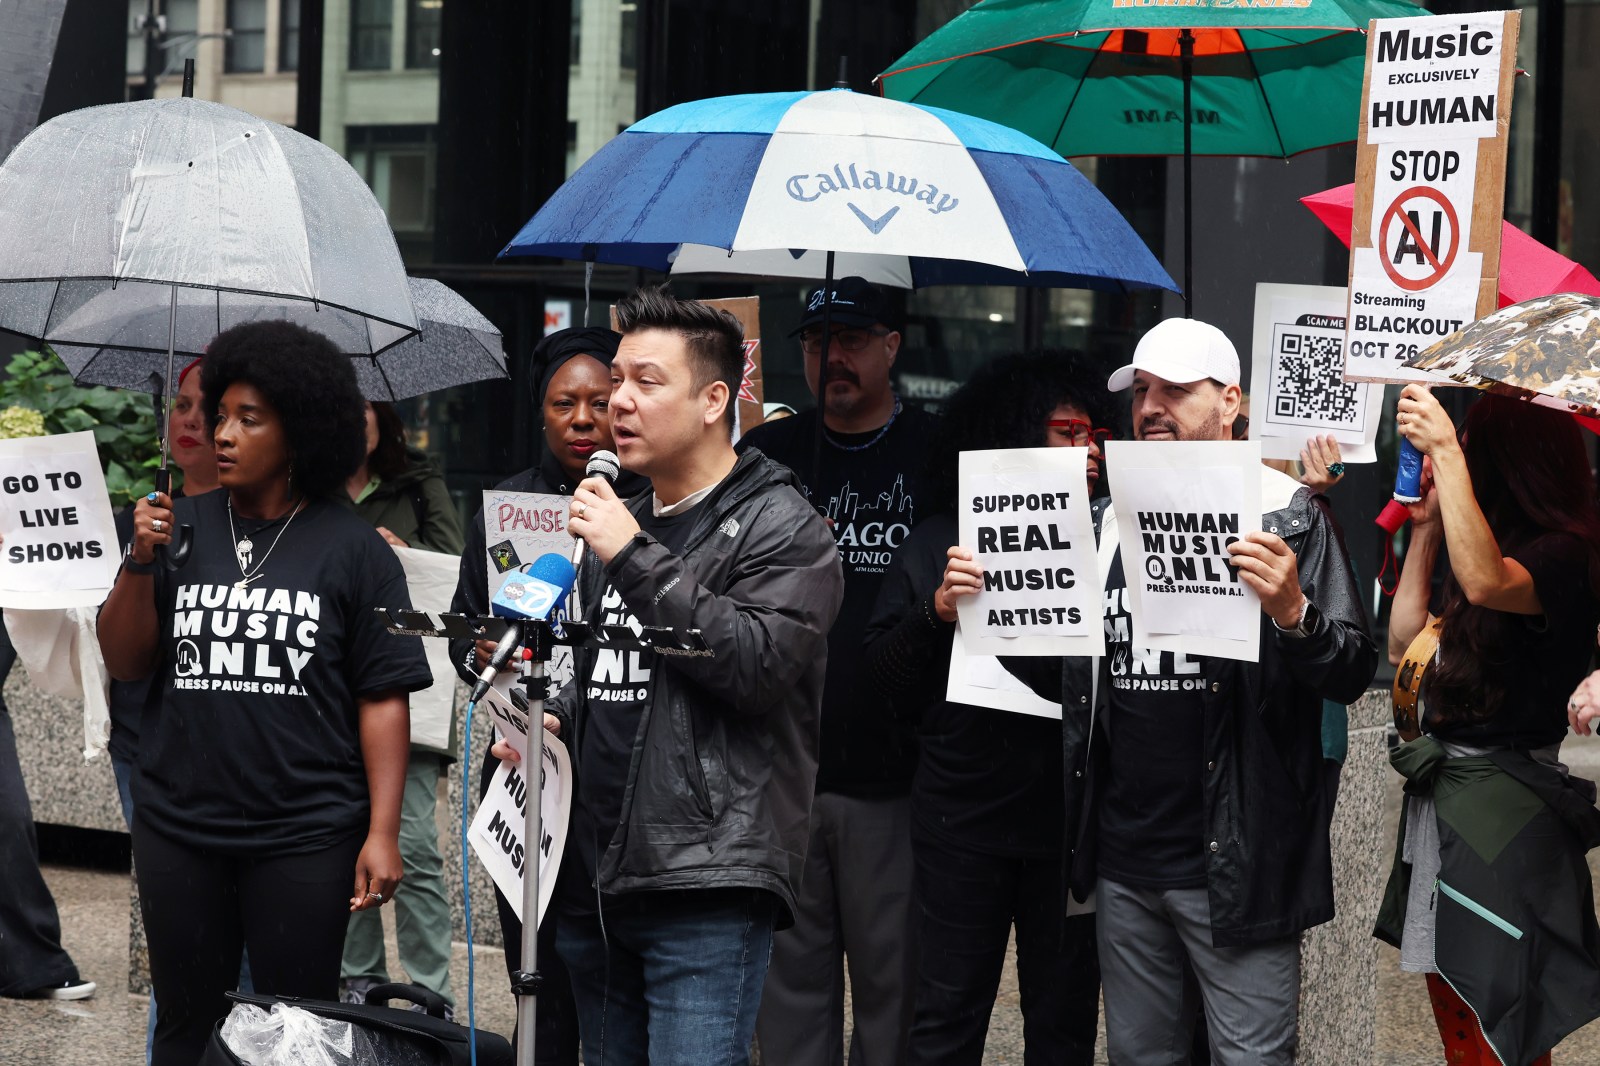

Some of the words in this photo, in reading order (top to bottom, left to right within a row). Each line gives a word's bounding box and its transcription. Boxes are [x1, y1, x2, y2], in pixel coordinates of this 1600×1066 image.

[1377, 24, 1494, 63] Music
[1388, 68, 1479, 85] EXCLUSIVELY
[1372, 95, 1495, 128] HUMAN
[1390, 150, 1460, 182] STOP
[786, 162, 959, 214] Callaway
[1393, 210, 1442, 265] AI
[1354, 292, 1426, 311] Streaming
[1306, 315, 1329, 327] SCAN
[1330, 319, 1344, 328] ME
[1354, 315, 1463, 336] BLACKOUT
[1350, 340, 1389, 359] OCT
[1395, 343, 1418, 360] 26
[2, 475, 39, 494] GO
[45, 471, 82, 491] TO
[972, 492, 1070, 514] SUPPORT
[19, 506, 79, 528] LIVE
[498, 503, 565, 533] PAUSE
[1137, 511, 1239, 534] HUMAN
[834, 522, 910, 548] AGO
[978, 523, 1071, 553] REAL
[8, 540, 103, 564] SHOWS
[849, 551, 892, 565] UNIO
[983, 567, 1076, 592] MUSIC
[1147, 584, 1176, 593] PRESS
[1178, 584, 1211, 595] PAUSE
[1212, 587, 1227, 596] ON
[1228, 588, 1244, 597] A.I.
[175, 584, 321, 621] HUMAN
[987, 606, 1082, 626] ARTISTS
[173, 610, 320, 648] MUSIC
[212, 679, 260, 693] PAUSE
[262, 682, 285, 695] ON
[590, 687, 634, 701] PAUSE
[1133, 679, 1179, 691] PAUSE
[1182, 679, 1207, 691] ON
